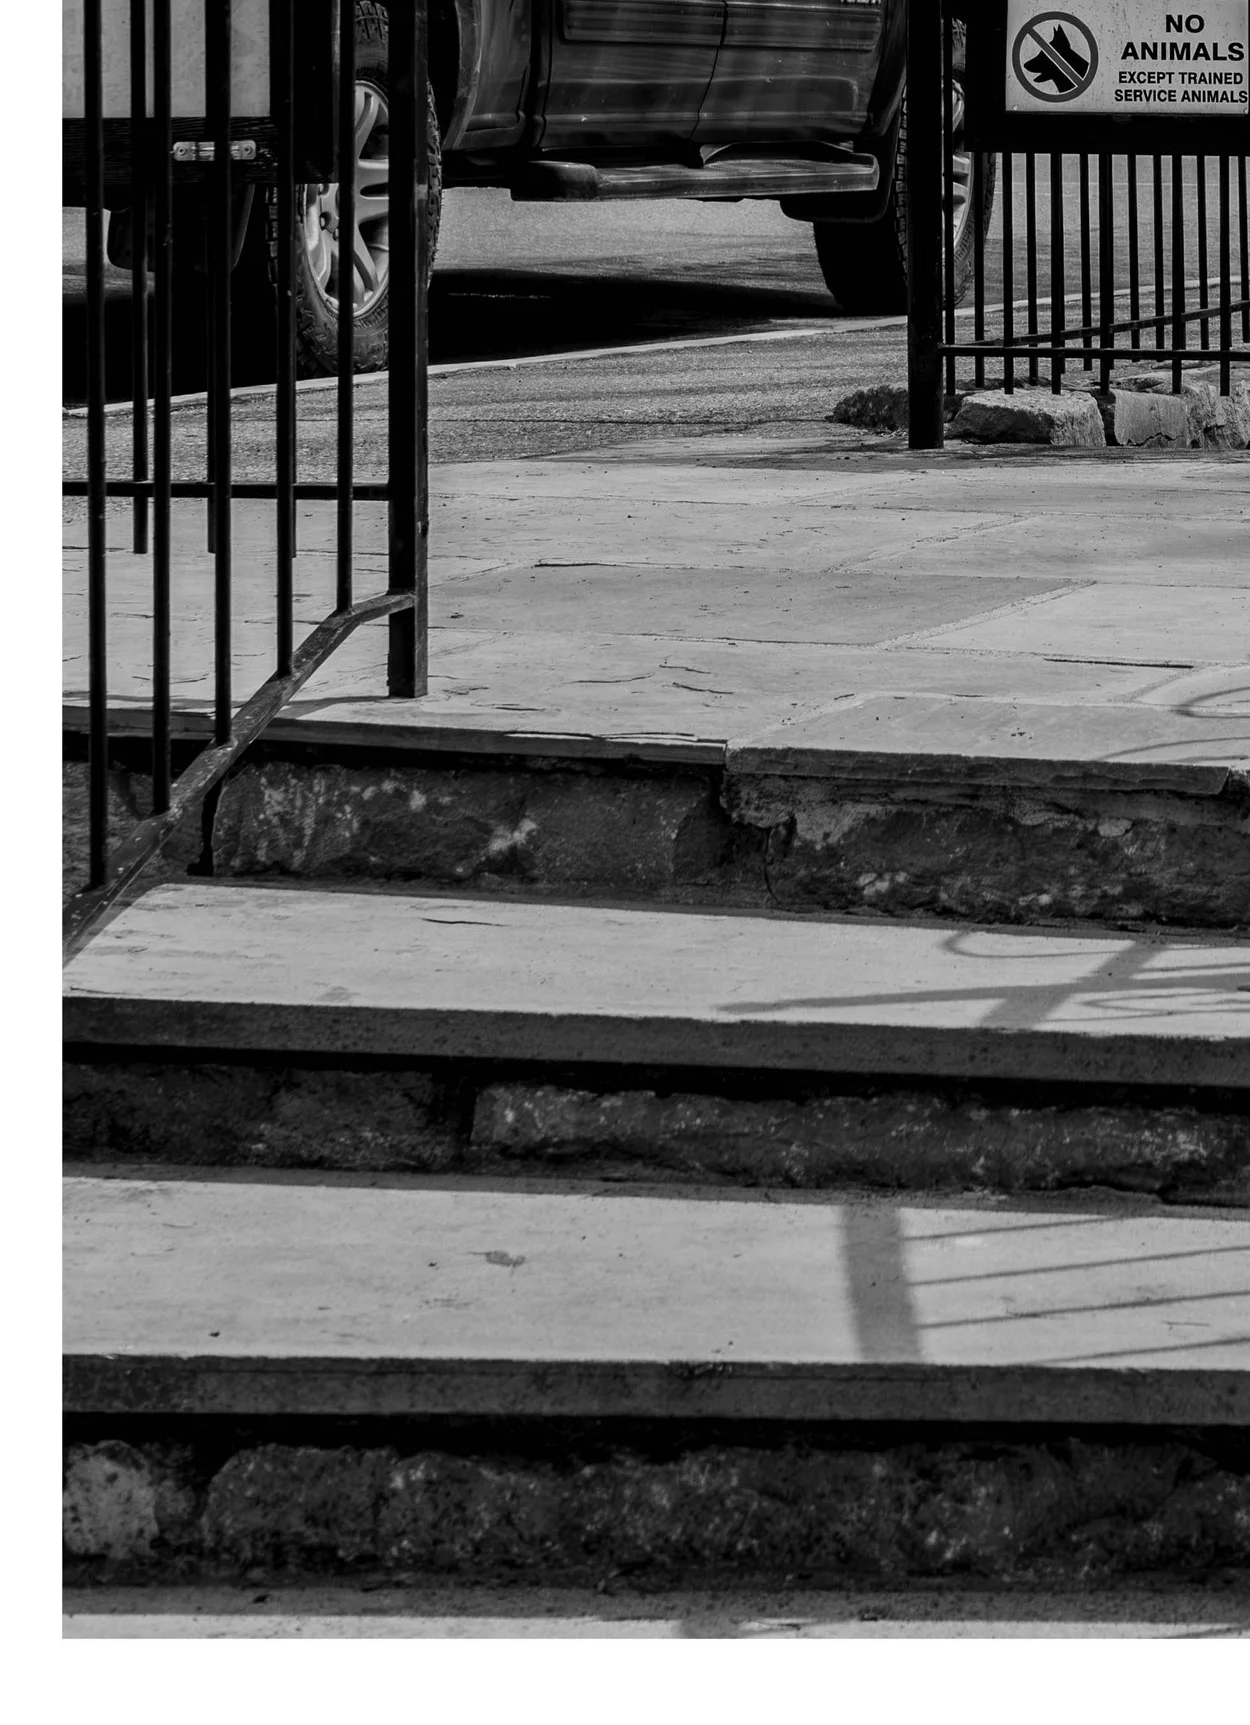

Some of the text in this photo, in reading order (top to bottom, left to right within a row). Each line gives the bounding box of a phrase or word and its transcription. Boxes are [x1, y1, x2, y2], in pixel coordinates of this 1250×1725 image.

[1165, 14, 1204, 33] NO
[1121, 42, 1245, 61] ANIMALS
[1118, 71, 1243, 85] EXCEPT TRAINED
[1114, 89, 1248, 104] SERVICE ANIMALS
